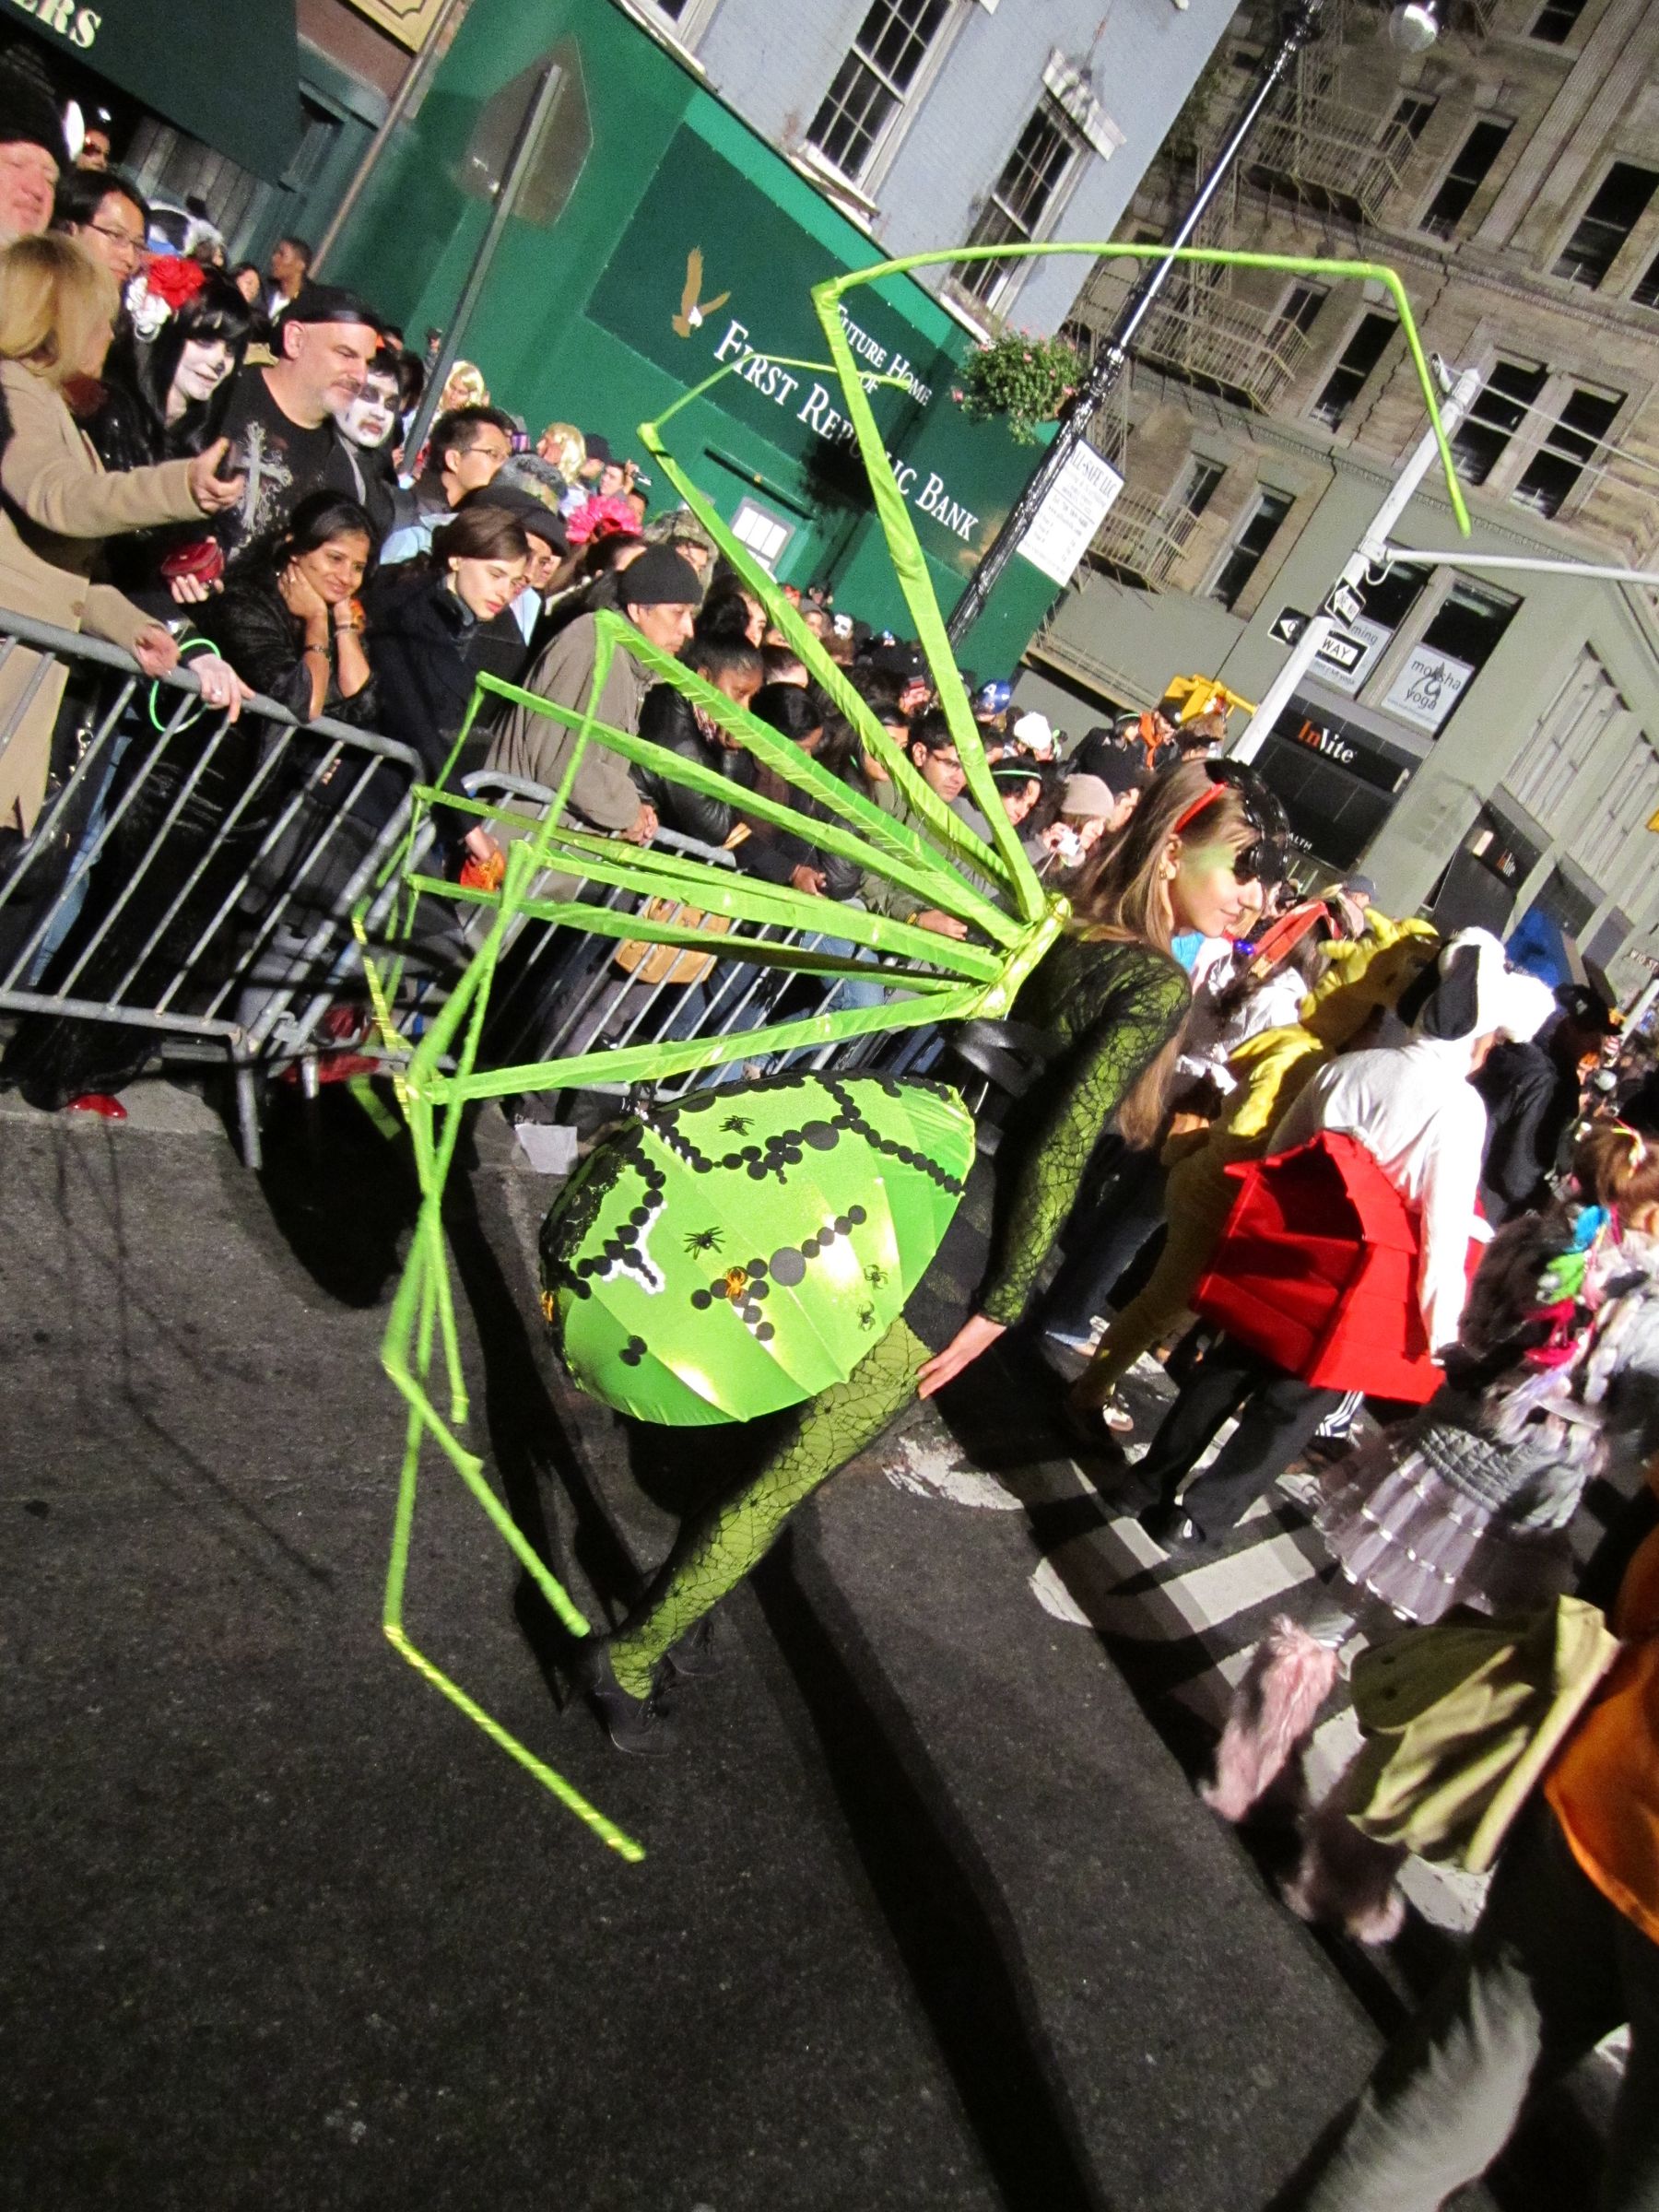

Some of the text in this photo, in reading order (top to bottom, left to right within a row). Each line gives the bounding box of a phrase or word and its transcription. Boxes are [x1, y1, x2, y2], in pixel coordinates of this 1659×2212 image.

[11, 0, 101, 48] RS
[713, 320, 799, 406] FIRST
[796, 382, 917, 495] REPUIC
[915, 472, 979, 542] BANK
[1351, 625, 1379, 646] ming
[1322, 638, 1351, 659] WAY
[1404, 688, 1438, 712] yoga
[1288, 831, 1313, 851] ALTH
